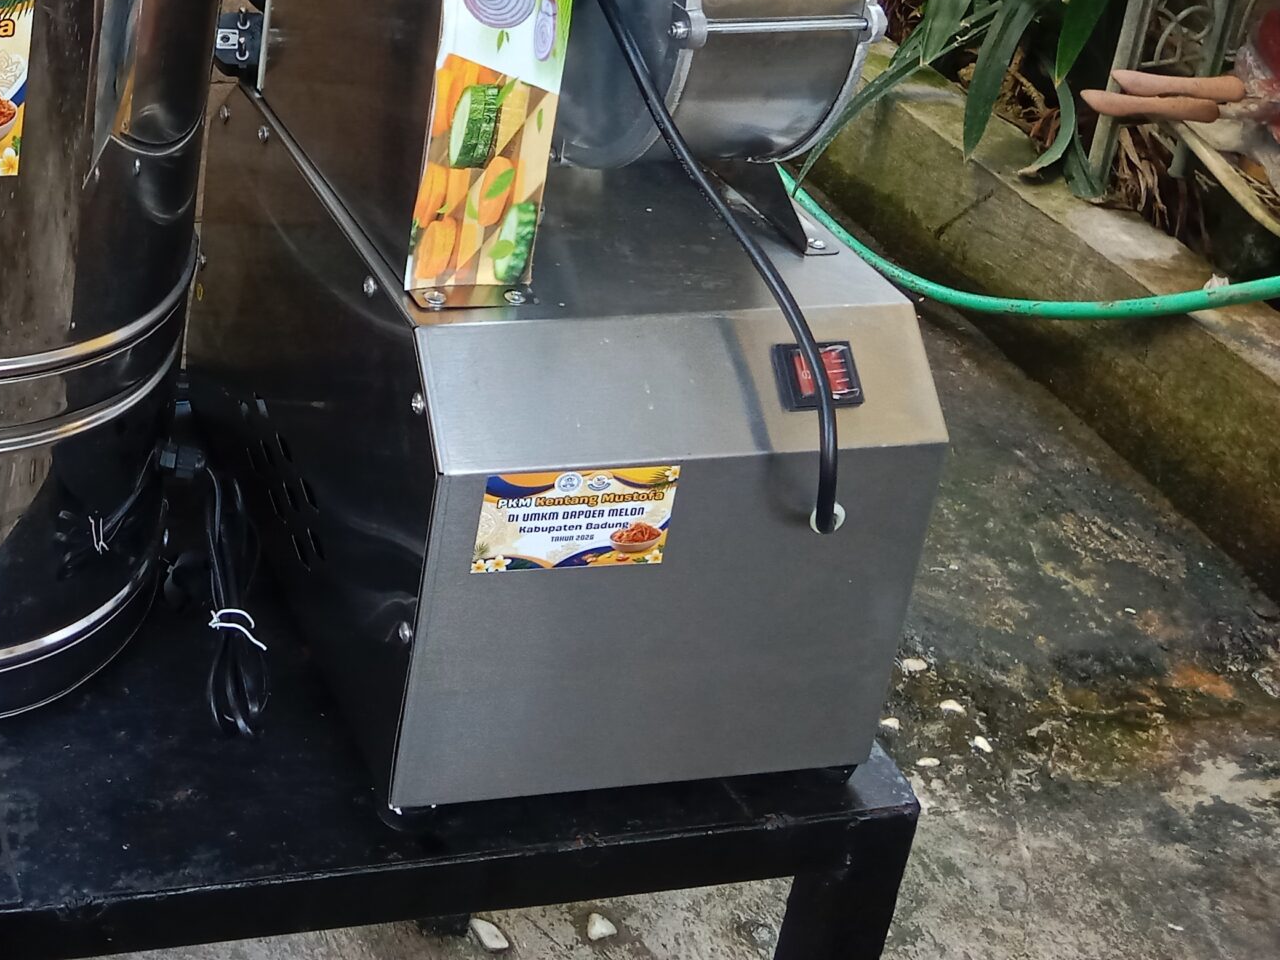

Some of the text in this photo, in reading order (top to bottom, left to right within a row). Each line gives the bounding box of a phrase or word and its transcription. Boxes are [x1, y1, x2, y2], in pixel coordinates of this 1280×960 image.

[497, 490, 665, 510] PKM Kentang Mustofa
[508, 506, 645, 523] DI UMKM DAPOER MELON
[519, 520, 629, 535] Kabupaten Badung
[550, 535, 575, 543] TAHUN
